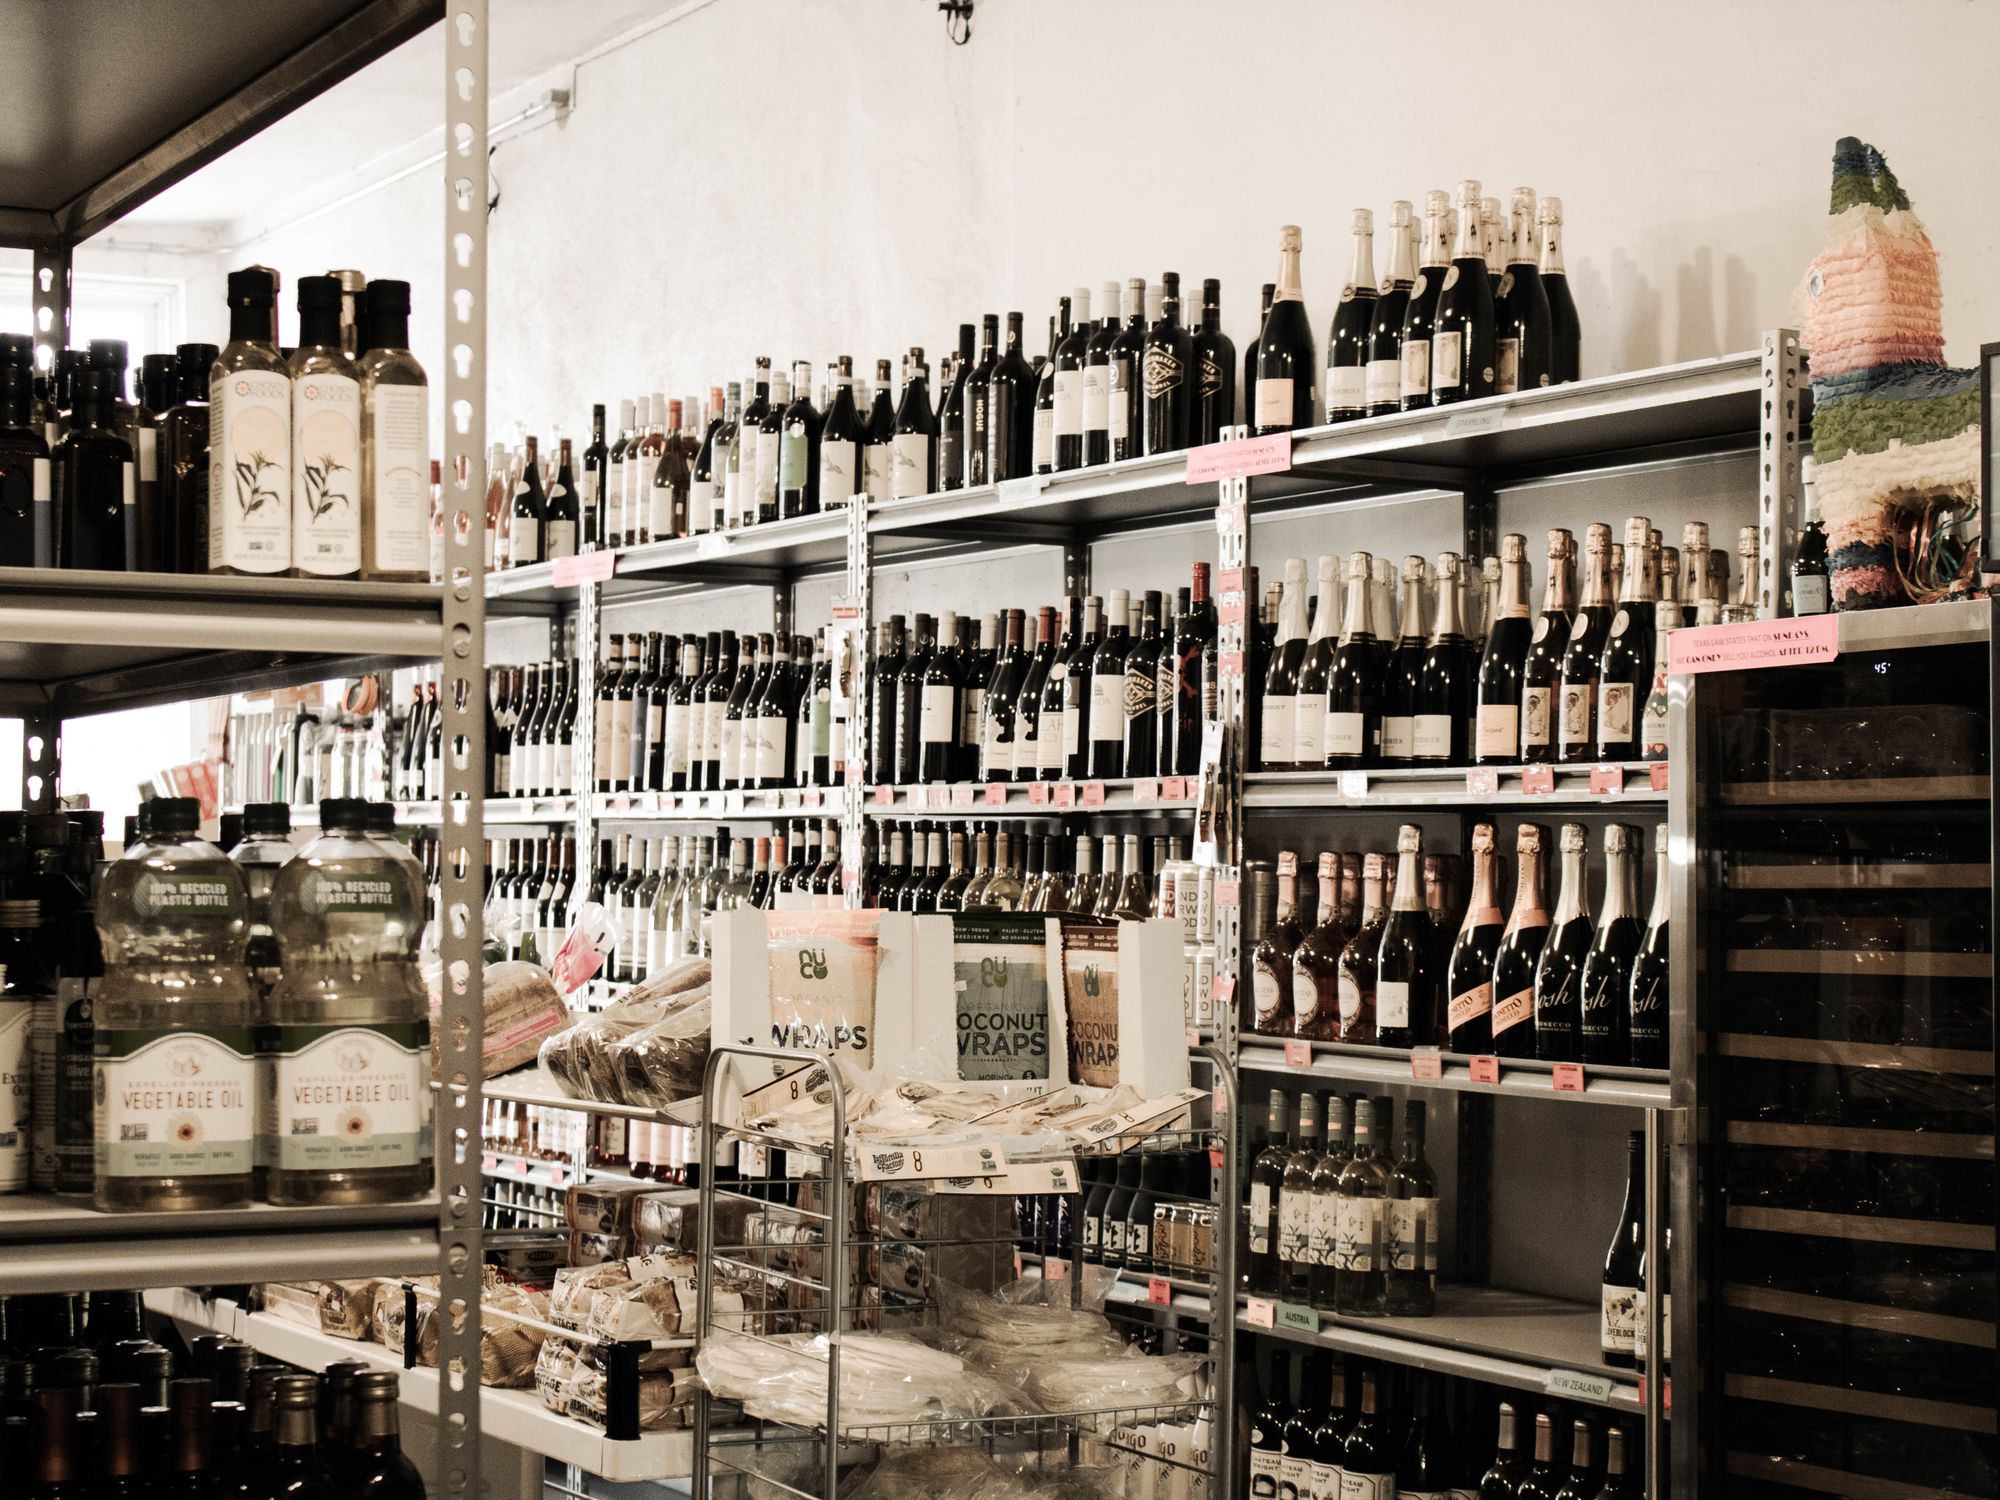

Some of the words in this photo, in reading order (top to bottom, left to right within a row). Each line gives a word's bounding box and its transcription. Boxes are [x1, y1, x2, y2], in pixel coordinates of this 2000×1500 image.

[976, 399, 984, 432] HOGUE
[1693, 639, 1710, 648] TEXAS
[1711, 638, 1724, 647] LAW
[1725, 636, 1746, 646] STATES
[1747, 635, 1761, 644] THAT
[1763, 634, 1772, 642] ON
[1773, 630, 1809, 642] SUNDAYS
[1676, 656, 1685, 665] WE
[1686, 655, 1701, 664] CAN
[1702, 654, 1721, 663] ONLY
[1723, 653, 1735, 661] SELL
[1736, 651, 1748, 660] YOU
[1749, 649, 1776, 659] ALCOHOL
[1778, 646, 1802, 657] AFTER
[179, 883, 227, 895] RECYCLED
[345, 881, 391, 893] RECYCLED
[149, 893, 192, 906] PLASTIC
[194, 894, 229, 907] BOTTLE
[315, 892, 357, 904] PLASTIC
[360, 892, 393, 905] BOTTLE
[957, 1013, 1048, 1031] OCONUT
[1072, 1022, 1118, 1042] COCONU
[1072, 1041, 1119, 1067] WRAP
[293, 1084, 382, 1104] VEGETABLE
[389, 1083, 411, 1101] OIL
[790, 1080, 799, 1100] 8
[122, 1090, 214, 1110] VEGETABLE
[221, 1089, 244, 1109] OIL
[881, 1151, 904, 1162] Tortilla
[913, 1151, 923, 1172] 8
[877, 1159, 905, 1174] Factory
[1285, 1312, 1310, 1326] AUSTRIA
[1552, 1376, 1569, 1389] NEW
[1570, 1380, 1603, 1396] ZEALAND
